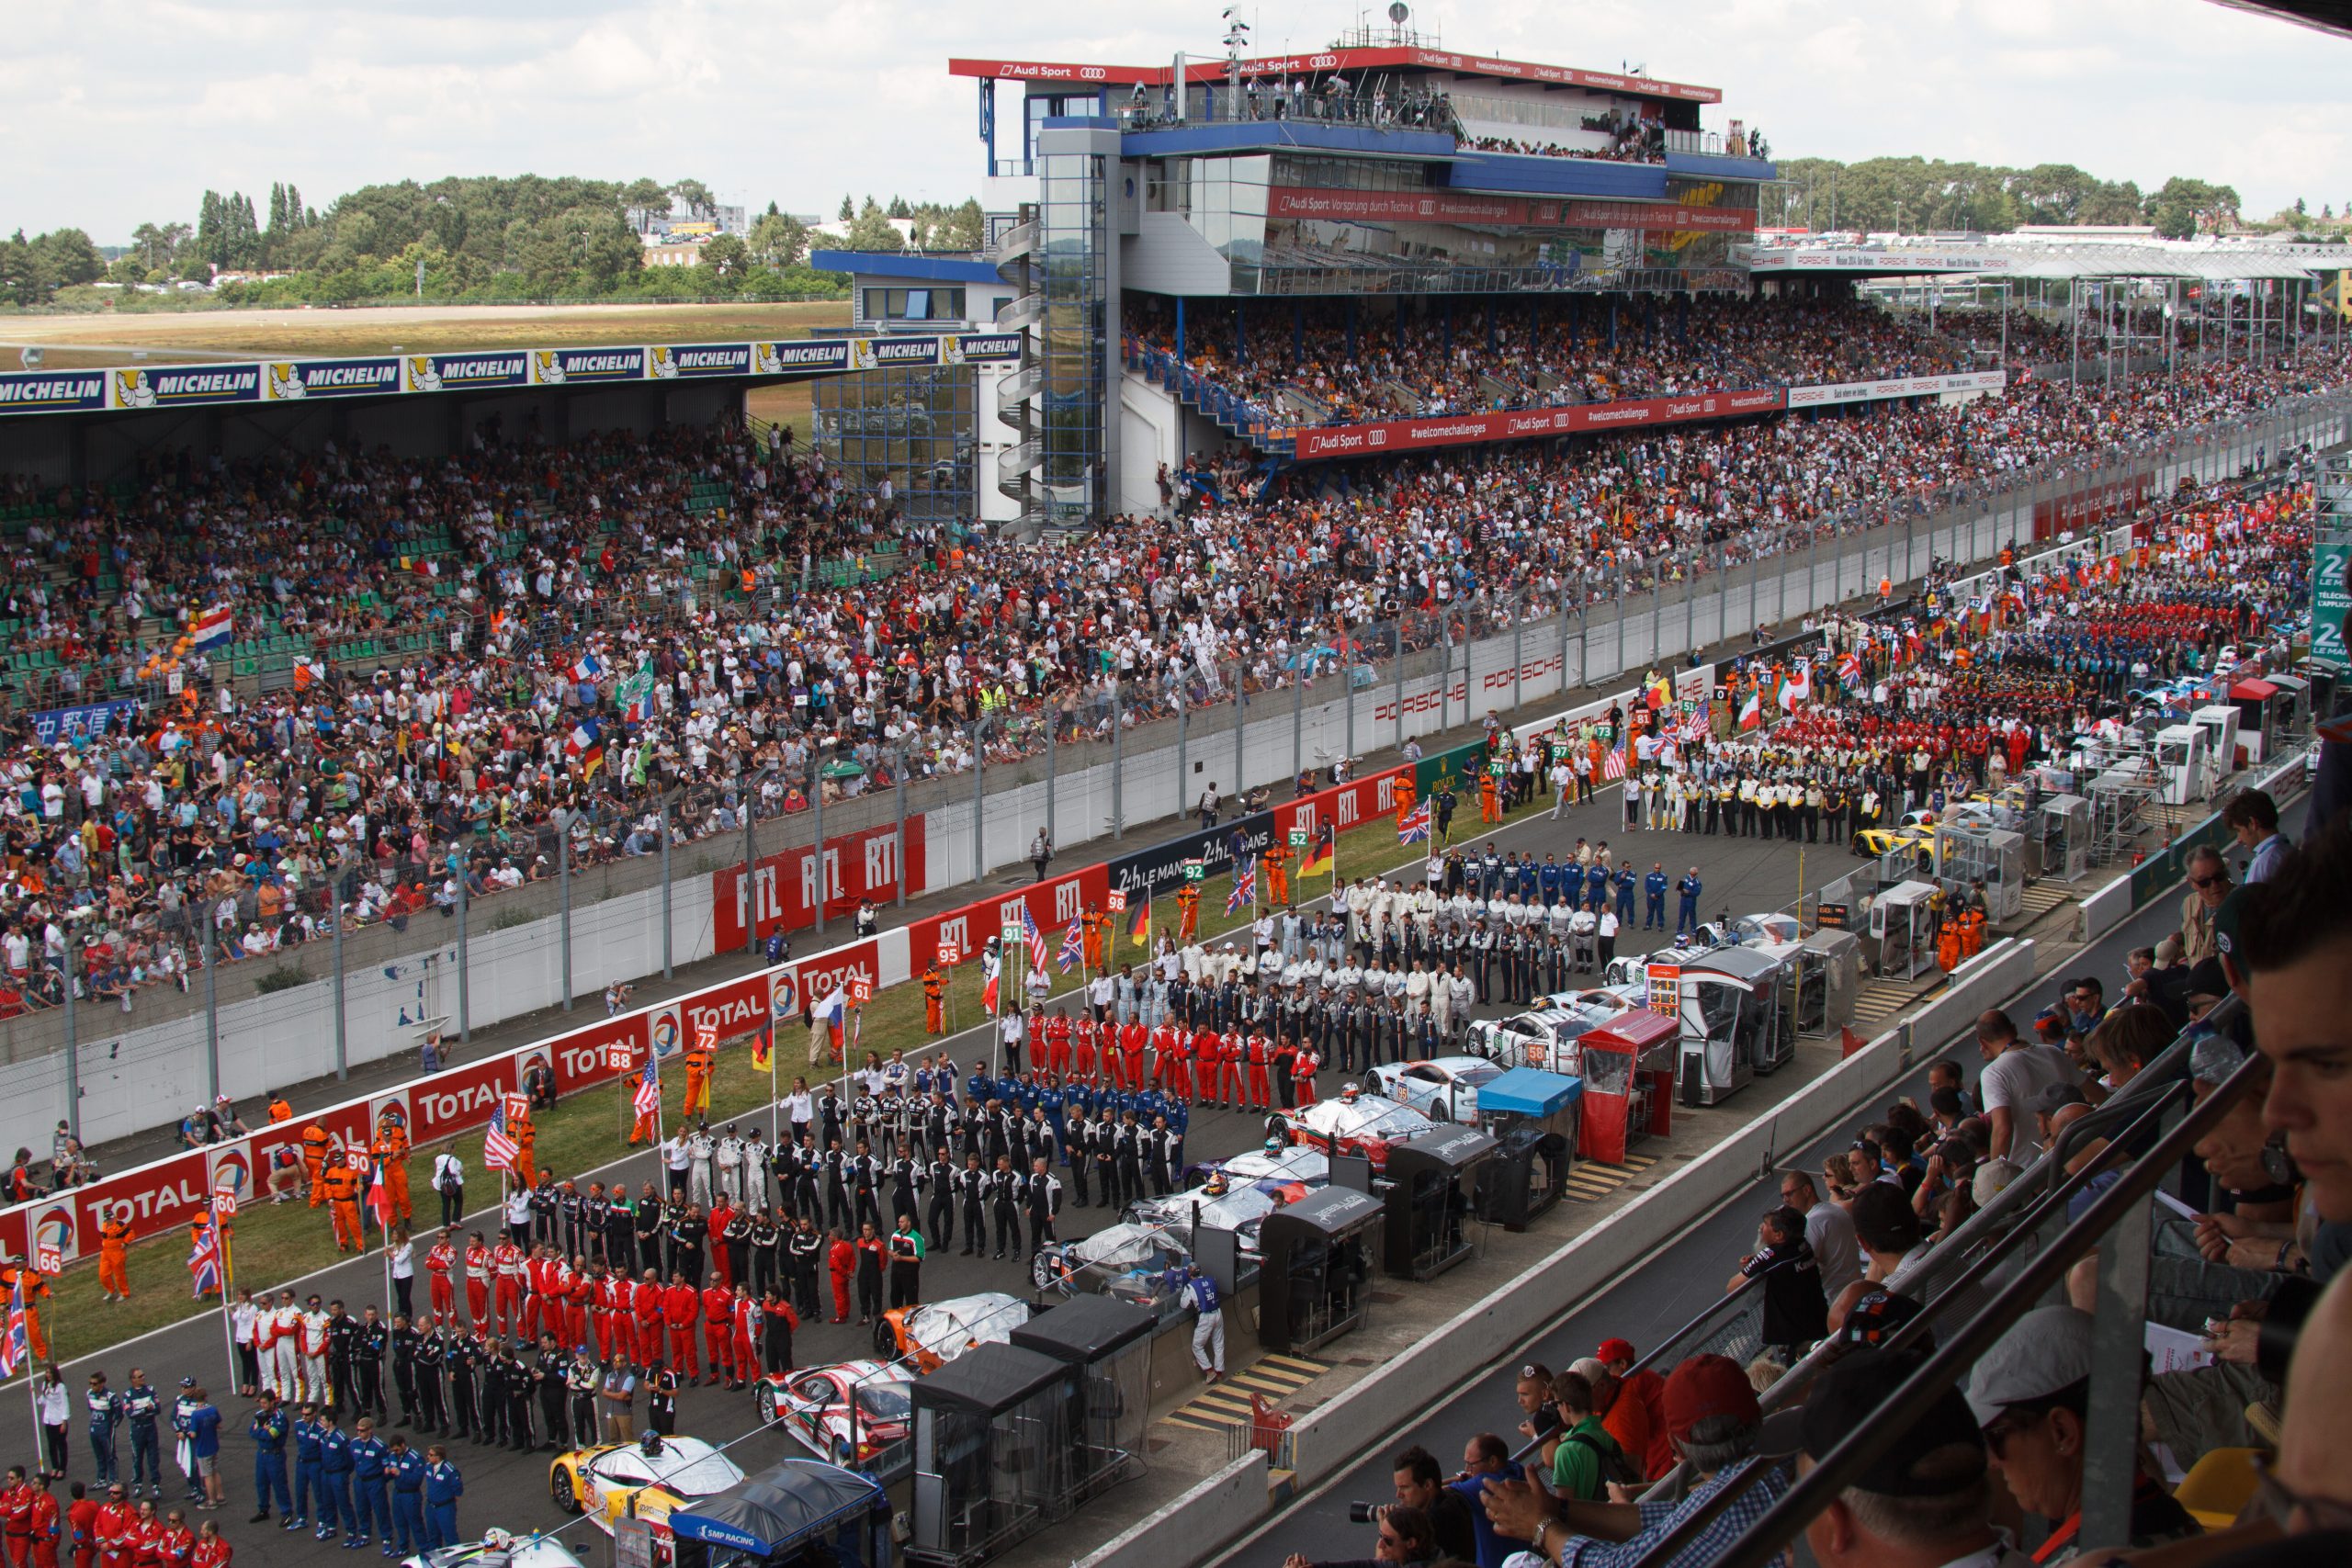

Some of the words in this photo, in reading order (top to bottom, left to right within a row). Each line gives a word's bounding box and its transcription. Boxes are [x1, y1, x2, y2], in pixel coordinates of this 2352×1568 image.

[1013, 65, 1037, 74] Audi
[1041, 66, 1070, 77] Sport
[1239, 63, 1264, 73] Audi
[1268, 60, 1299, 72] Sport
[1290, 197, 1306, 209] Audi
[1308, 197, 1329, 211] Sport
[1332, 198, 1367, 213] Vorsprung
[1369, 199, 1388, 211] durch
[1391, 200, 1415, 212] Technik
[1441, 203, 1508, 217] #welcomechallenges
[1798, 256, 1830, 265] PORSCHE
[782, 346, 846, 362] MICHELIN
[878, 344, 936, 358] MICHELIN
[965, 340, 1019, 354] MICHELIN
[566, 355, 641, 371] MICHELIN
[679, 351, 748, 367] MICHELIN
[443, 359, 525, 378] MICHELIN
[157, 373, 256, 394] MICHELIN
[306, 367, 397, 386] MICHELIN
[0, 380, 102, 400] MICHELIN
[1792, 390, 1825, 401] PORSCHE
[1589, 407, 1649, 422] #welcomechallenges
[1672, 403, 1685, 414] Audi
[1686, 402, 1701, 414] Sport
[1411, 423, 1487, 438] #welcomechallenges
[1516, 419, 1531, 430] Audi
[1532, 417, 1550, 431] Sport
[1320, 435, 1339, 449] Audi
[1340, 434, 1363, 449] Sport
[1795, 660, 1807, 671] 50
[1759, 674, 1771, 683] 41
[1717, 690, 1724, 699] 0
[1683, 701, 1695, 711] 51
[1636, 714, 1649, 724] 81
[1599, 726, 1611, 737] 73
[1554, 746, 1566, 757] 97
[1491, 763, 1503, 774] 74
[1432, 775, 1455, 793] ROLEX
[1338, 788, 1360, 827] RTL
[1245, 831, 1268, 851] ANS
[1290, 833, 1306, 845] 52
[1185, 865, 1203, 878] 92
[1142, 873, 1155, 886] LE
[1109, 897, 1125, 910] 98
[1004, 928, 1020, 941] 91
[939, 948, 958, 964] 95
[854, 976, 871, 985] MOTUL
[854, 985, 869, 1000] 61
[688, 995, 764, 1030] TOTAL
[697, 1024, 717, 1032] MOTUL
[610, 1043, 631, 1052] MOTUL
[698, 1032, 716, 1049] 72
[560, 1034, 644, 1078] TOTL
[1530, 1047, 1544, 1058] 58
[610, 1052, 631, 1068] 88
[418, 1077, 508, 1124] TOTAL
[508, 1092, 528, 1101] MOTUL
[1398, 1087, 1408, 1100] 95
[510, 1101, 527, 1118] 77
[1297, 1130, 1307, 1145] 61
[261, 1126, 365, 1169] TOAL
[347, 1145, 368, 1154] MOTUL
[348, 1153, 369, 1172] 90
[215, 1185, 234, 1194] MOTUL
[86, 1179, 201, 1233] TOTAL
[216, 1195, 236, 1213] 60
[40, 1241, 61, 1252] MOTUL
[40, 1252, 62, 1273] 66
[583, 1485, 594, 1505] 66
[707, 1529, 724, 1540] SMP
[725, 1532, 754, 1546] RACING
